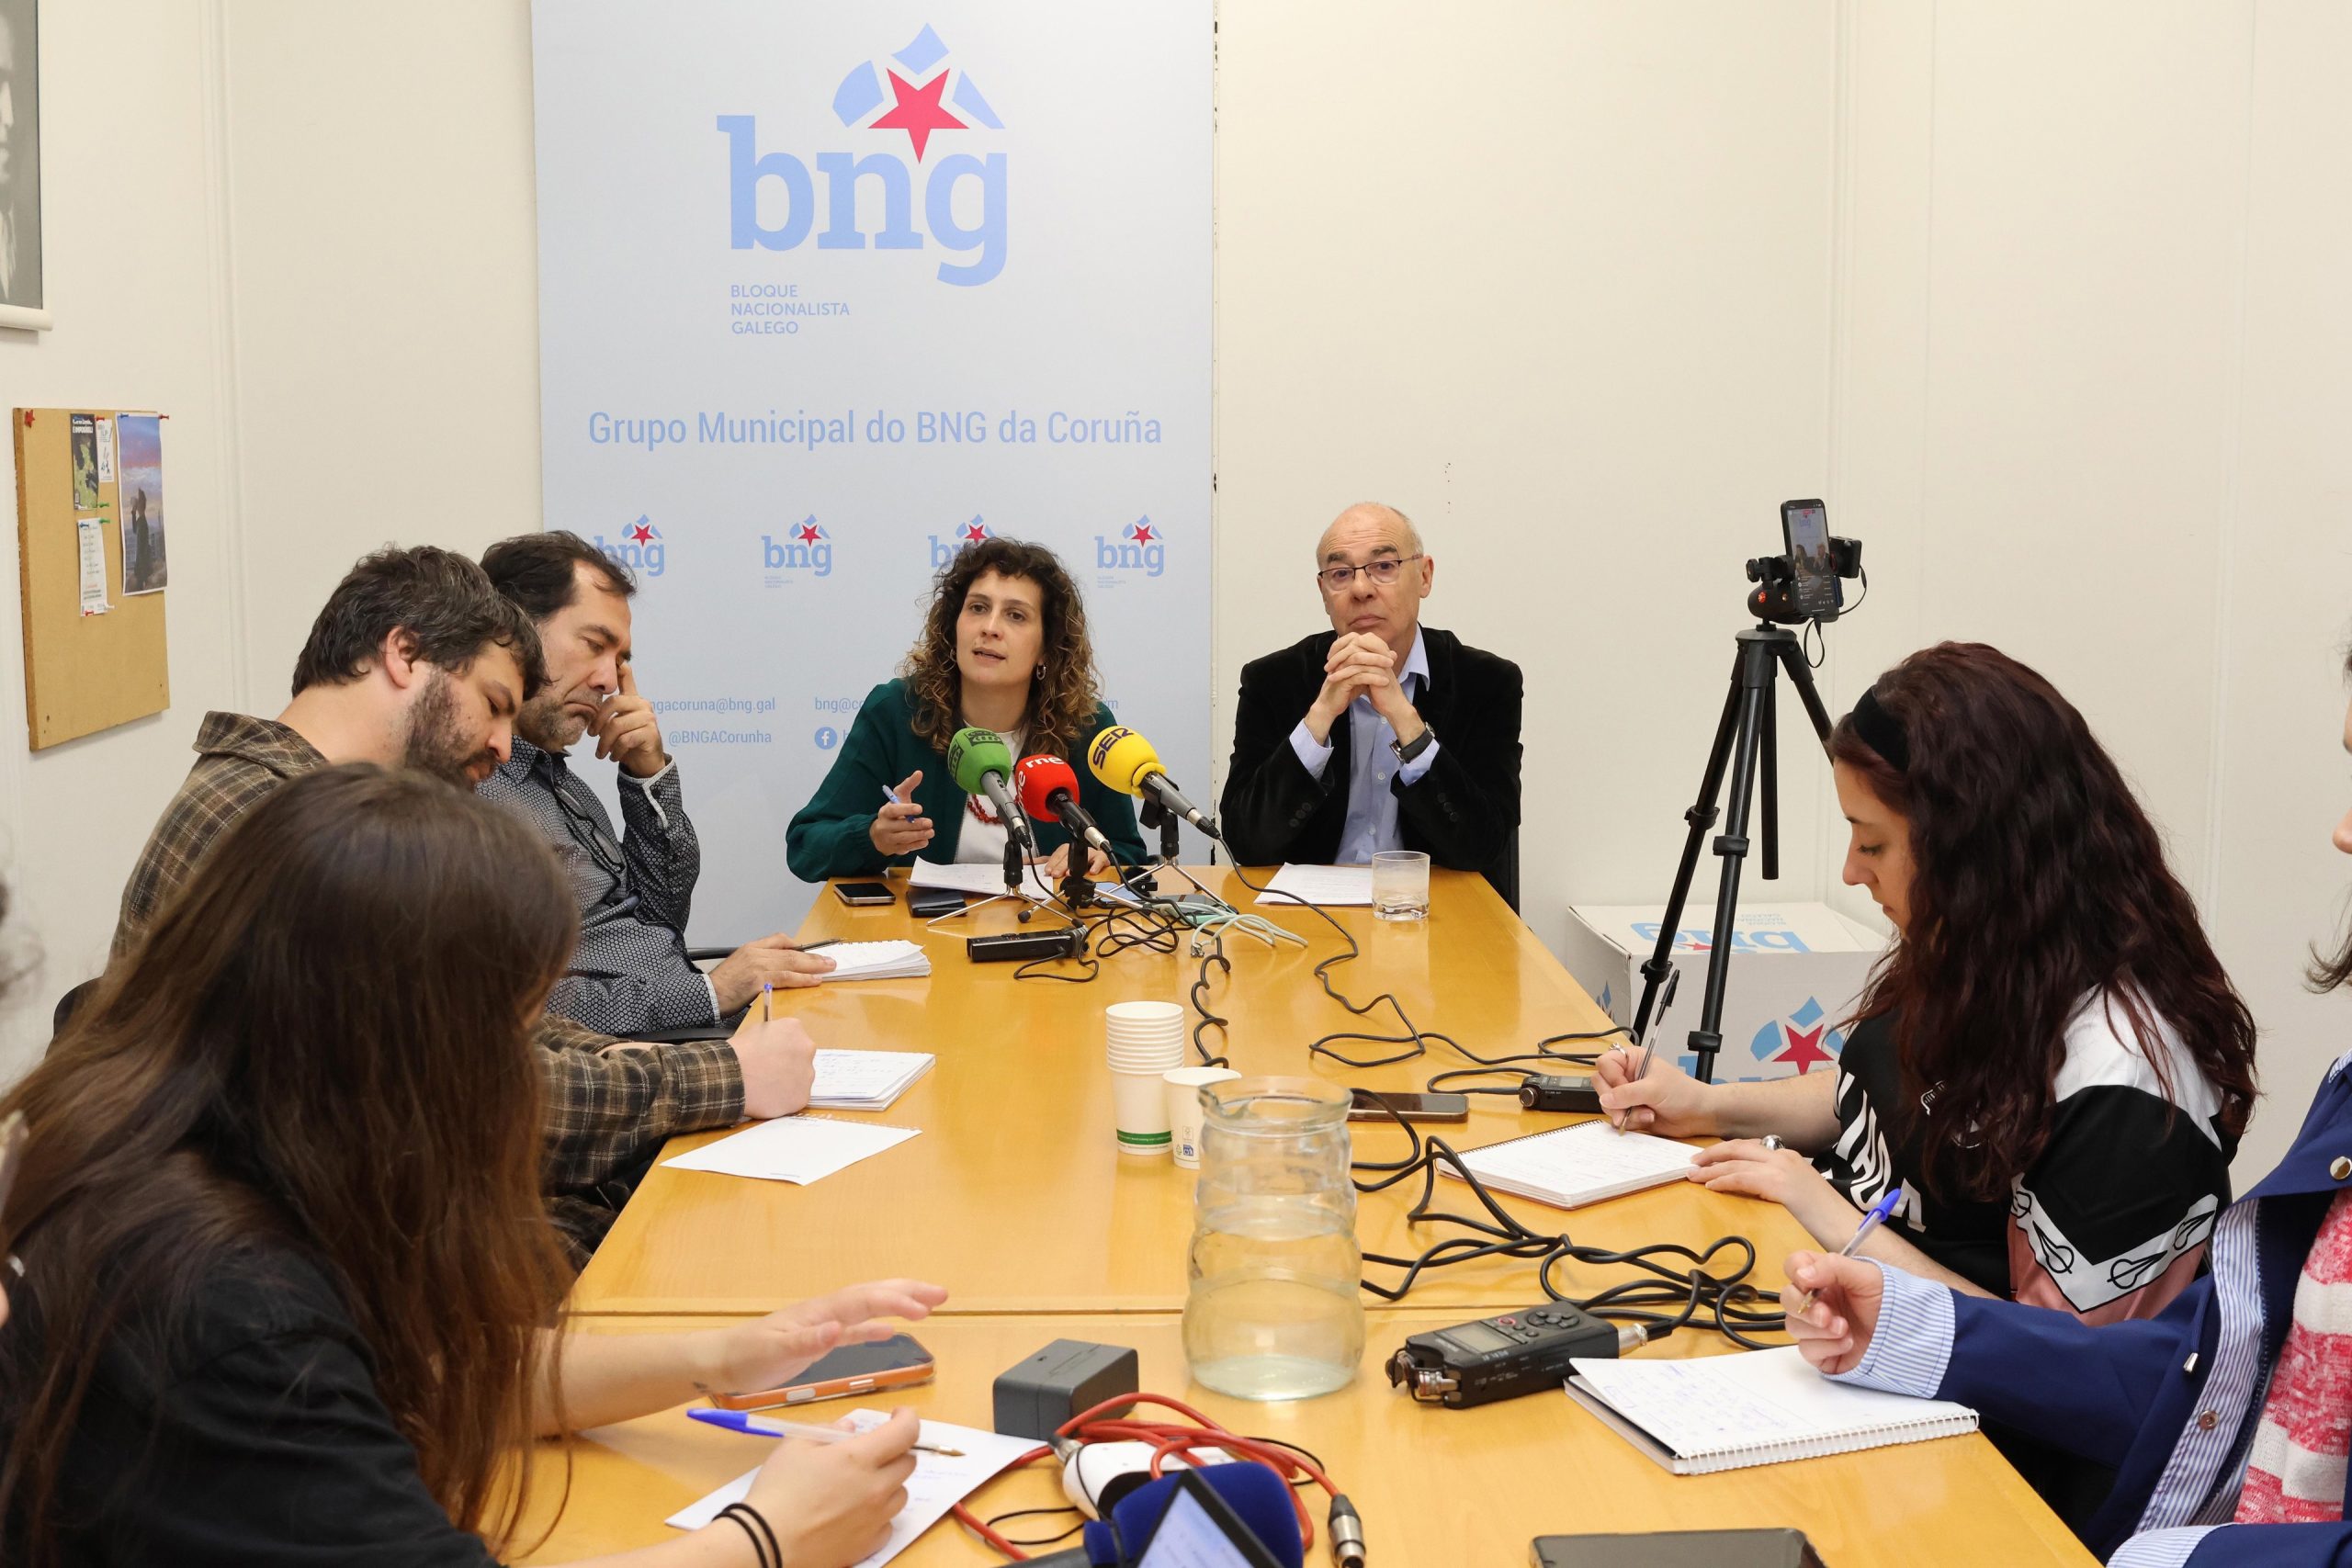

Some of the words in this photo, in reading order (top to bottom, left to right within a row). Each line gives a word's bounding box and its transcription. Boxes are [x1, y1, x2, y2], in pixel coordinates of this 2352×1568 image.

[717, 115, 1008, 287] bng
[730, 284, 798, 298] BLOQUE
[730, 302, 850, 316] NACIONALISTA
[731, 321, 798, 334] GALEGO
[588, 411, 687, 453] Grupo
[697, 410, 854, 452] Municipal
[865, 410, 906, 444] do
[916, 411, 987, 444] BNG
[998, 410, 1037, 444] da
[1046, 410, 1163, 444] Coruña
[762, 536, 832, 577] bng
[1094, 536, 1165, 578] bng
[650, 697, 775, 714] ngacoruna@bng.gal
[668, 730, 772, 746] @BNGACorunha
[1092, 728, 1135, 770] SER
[1025, 757, 1065, 769] rne
